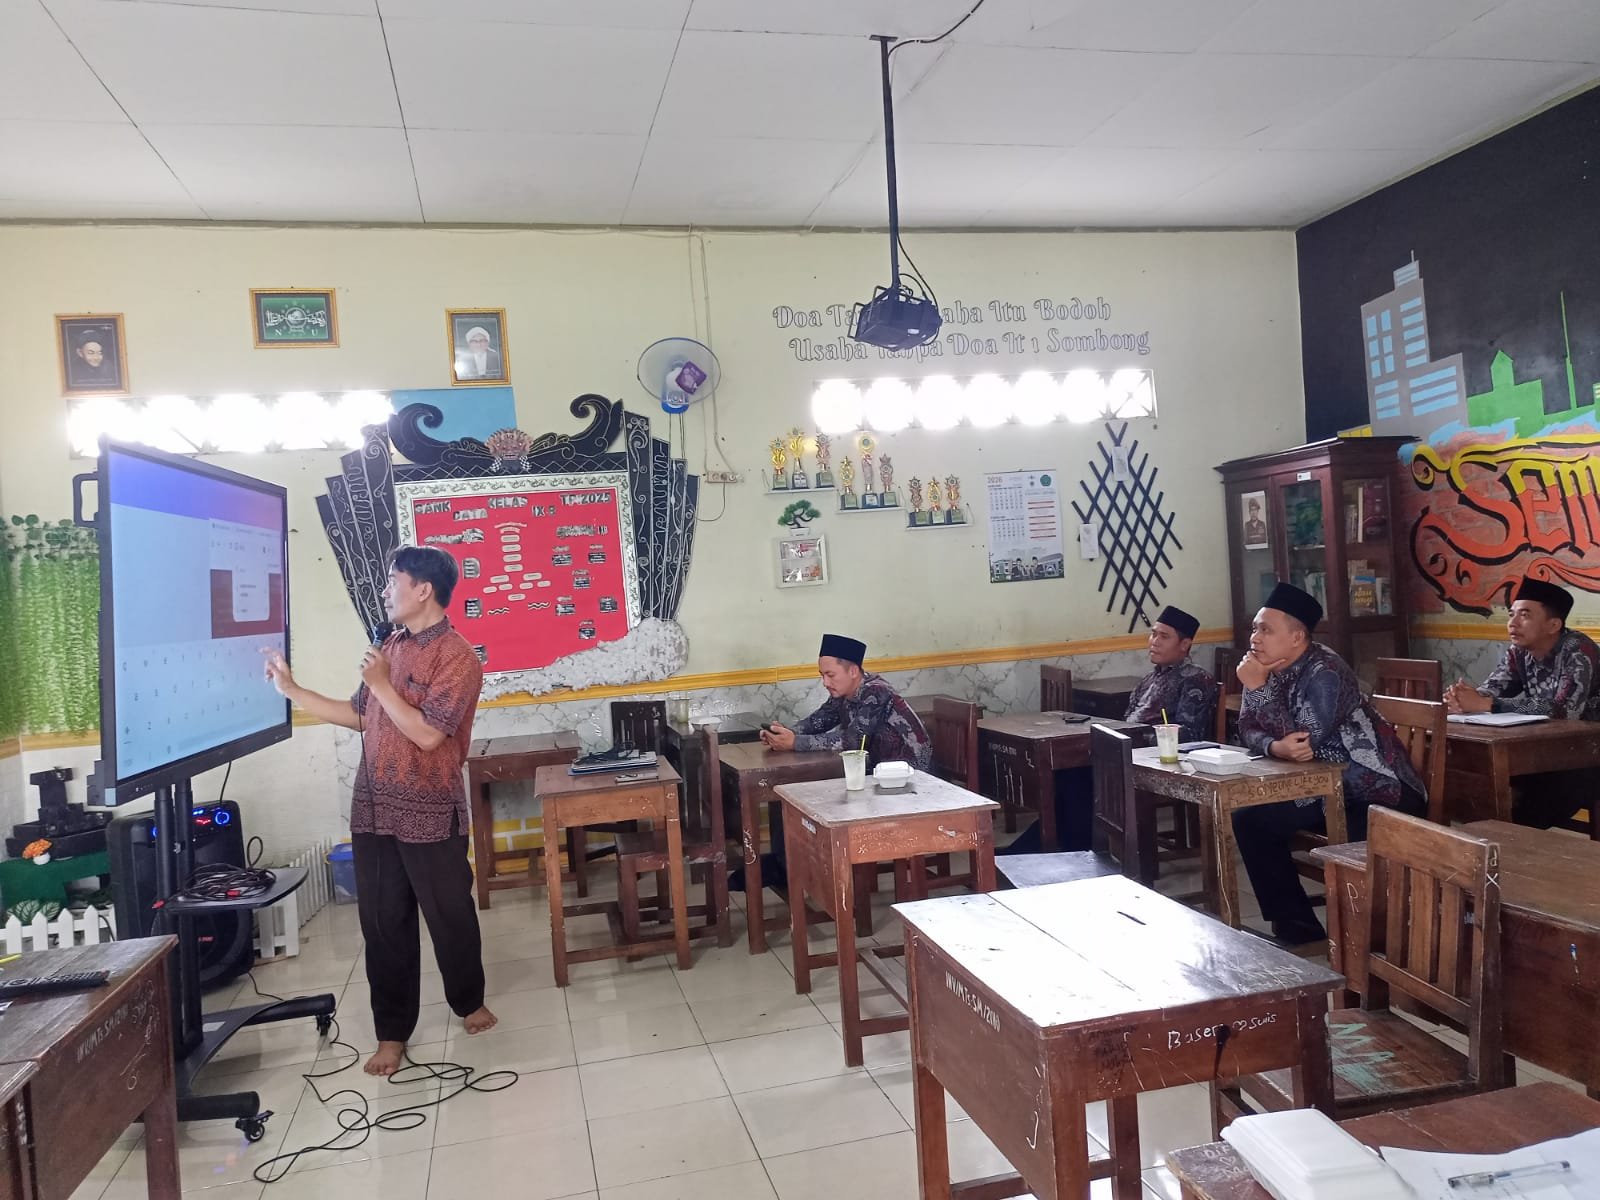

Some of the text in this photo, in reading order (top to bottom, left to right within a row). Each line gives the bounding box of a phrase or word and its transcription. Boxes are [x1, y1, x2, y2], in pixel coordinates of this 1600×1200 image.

[771, 304, 823, 329] Doa
[987, 299, 1027, 323] Itu
[1033, 296, 1112, 321] Bodoh
[788, 336, 868, 362] Usaha
[946, 332, 999, 356] Doa
[1046, 327, 1151, 356] Sombong
